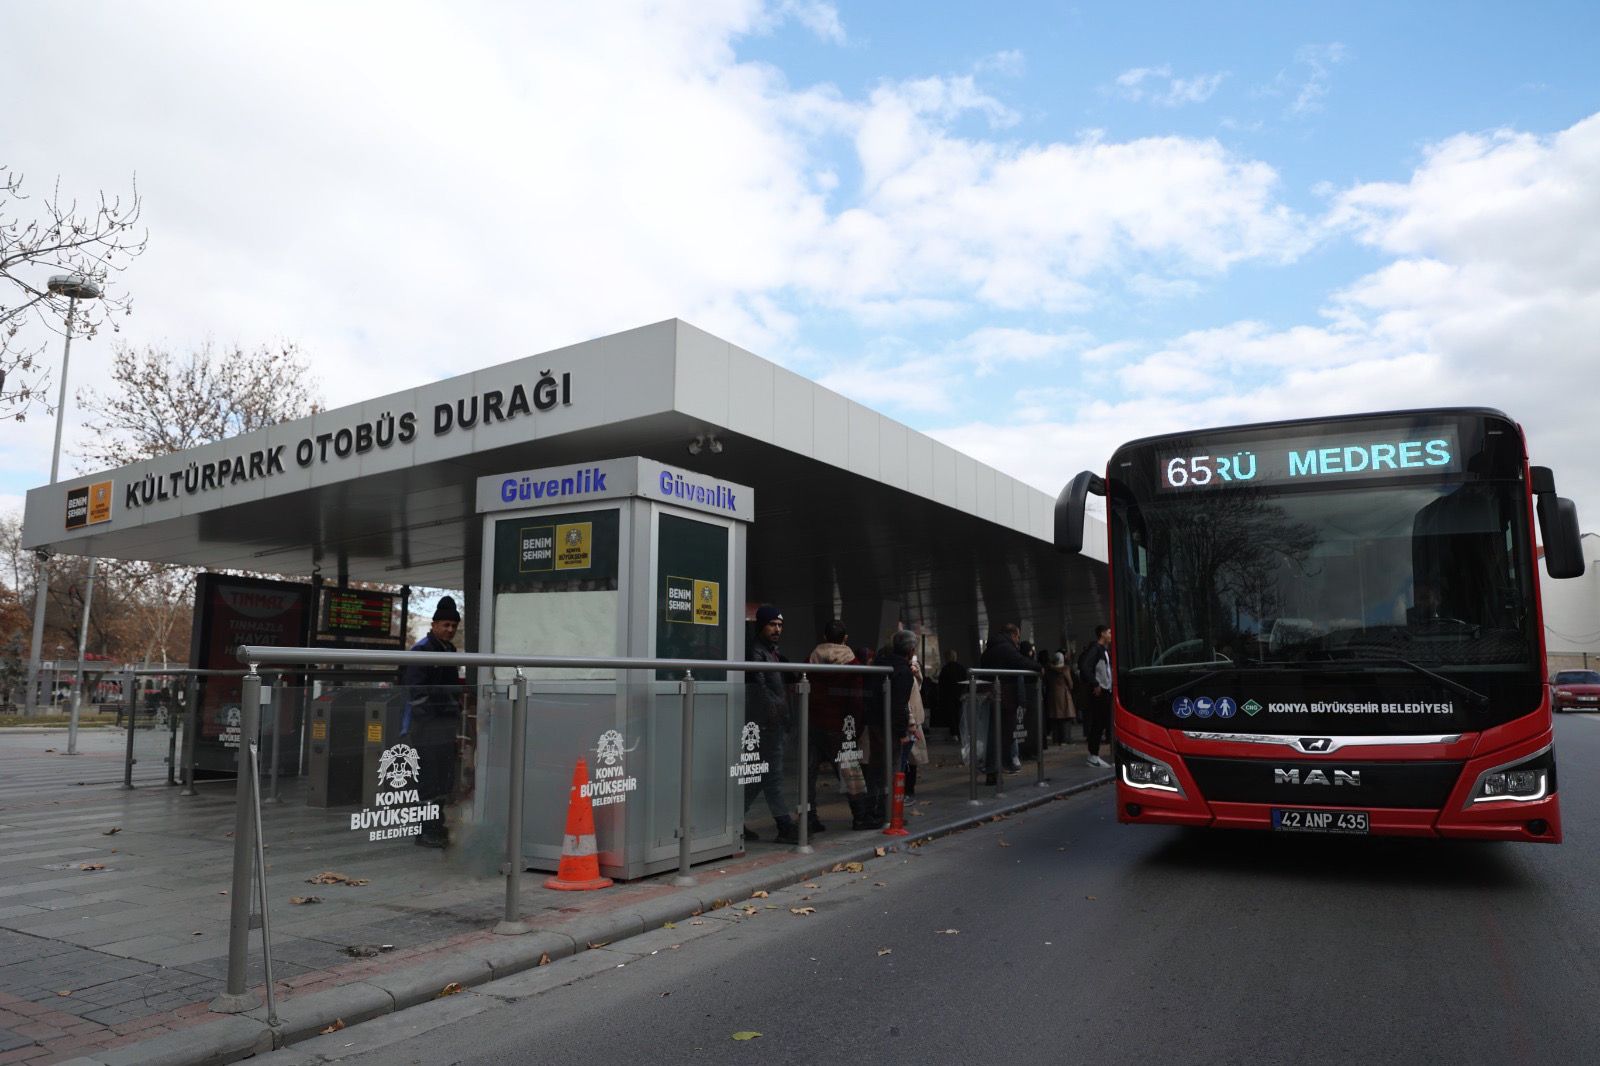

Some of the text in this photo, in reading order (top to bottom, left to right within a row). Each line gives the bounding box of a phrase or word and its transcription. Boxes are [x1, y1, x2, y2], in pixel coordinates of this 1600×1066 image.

[125, 370, 572, 508] KÜLTÜRPARK OTOBÜS DURAĞI
[1167, 455, 1213, 487] 65
[1289, 439, 1451, 476] MEDRES
[501, 468, 607, 503] Güvenlik
[659, 470, 737, 512] Güvenlik
[523, 537, 552, 550] BENİM
[522, 549, 552, 562] ŞEHRİM
[669, 587, 692, 600] BENİM
[668, 600, 692, 611] ŞEHRİM
[1268, 701, 1454, 714] KONYA BÜYÜKŞEHİR BELEDİYESİ
[740, 752, 760, 762] KONYA
[595, 765, 624, 780] KONYA
[730, 760, 769, 777] BÜYÜKŞEHİR
[1274, 768, 1361, 786] MAN
[580, 775, 637, 798] BÜYÜKŞEHİR
[375, 789, 420, 807] KONYA
[592, 792, 626, 807] BELEDİYESİ
[350, 801, 440, 831] BÜYÜKŞEHİR
[1281, 812, 1301, 827] 42
[1305, 813, 1333, 828] ANP
[1337, 814, 1366, 830] 435
[369, 822, 423, 842] BELEDİYESİ
